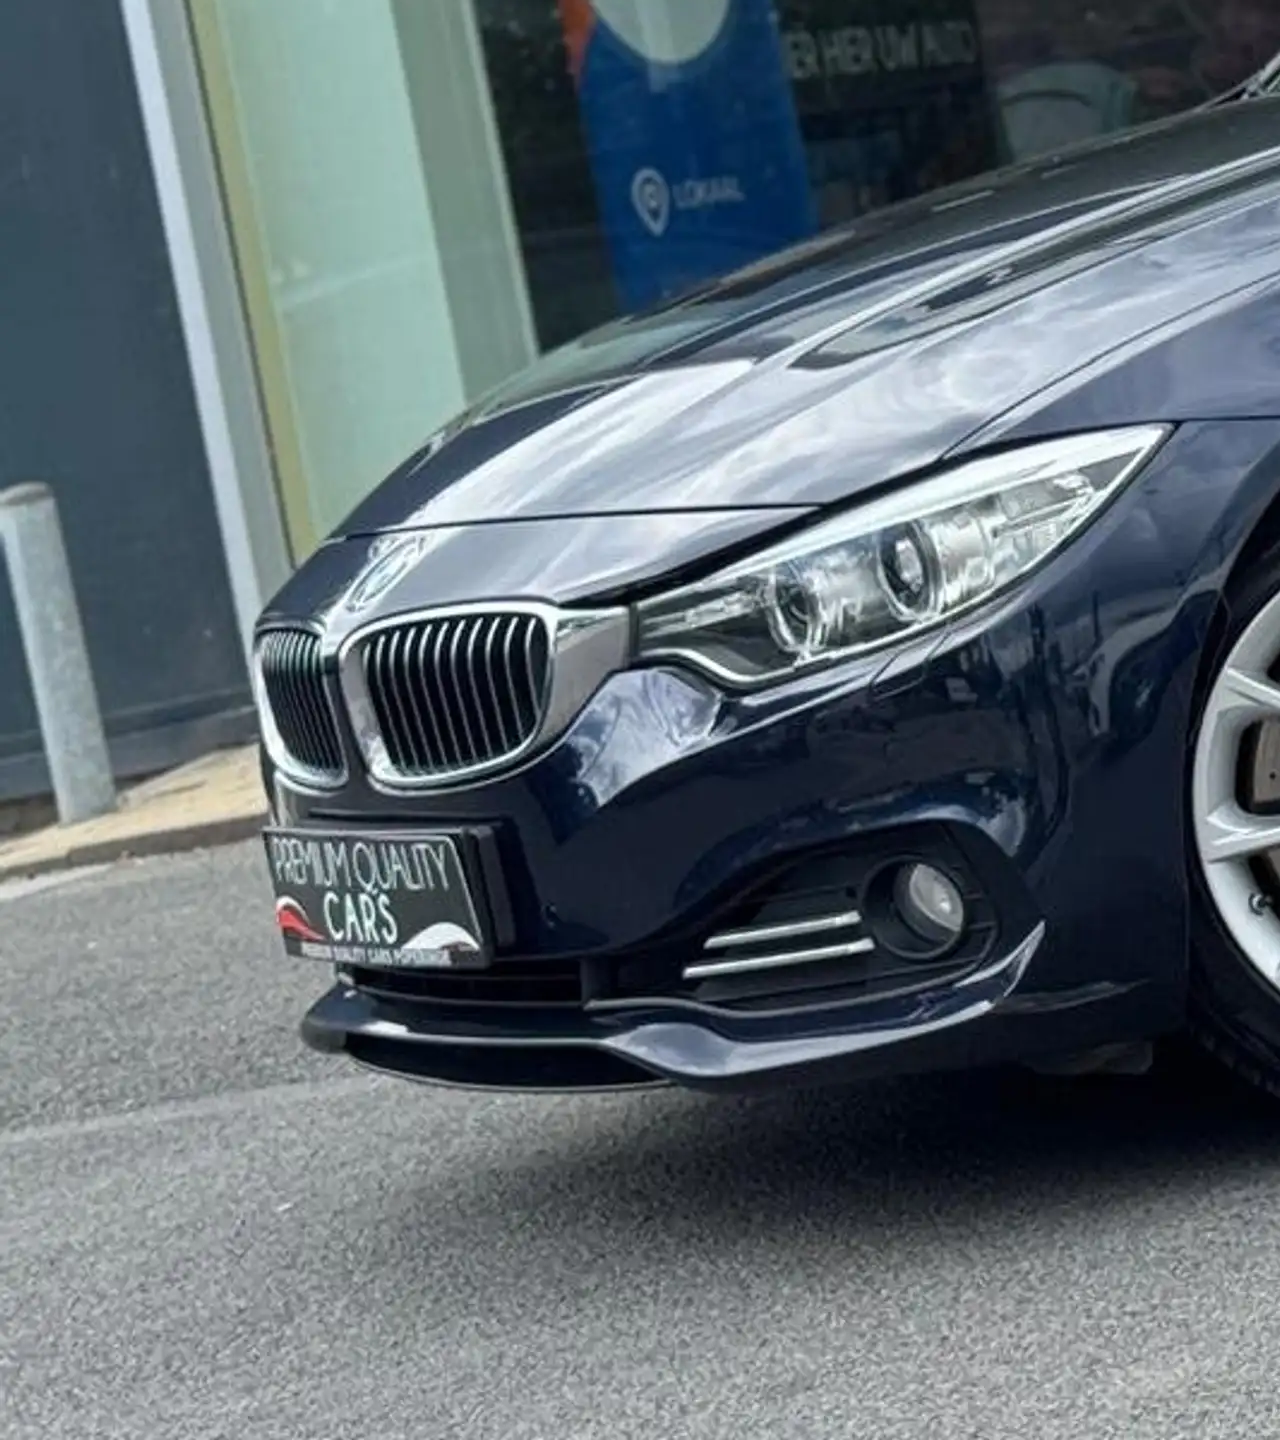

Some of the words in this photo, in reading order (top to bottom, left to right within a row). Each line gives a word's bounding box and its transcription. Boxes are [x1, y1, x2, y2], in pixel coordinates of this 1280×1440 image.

[271, 837, 351, 886] PREMIUM
[353, 841, 449, 895] QUALITY
[323, 891, 398, 944] CARS
